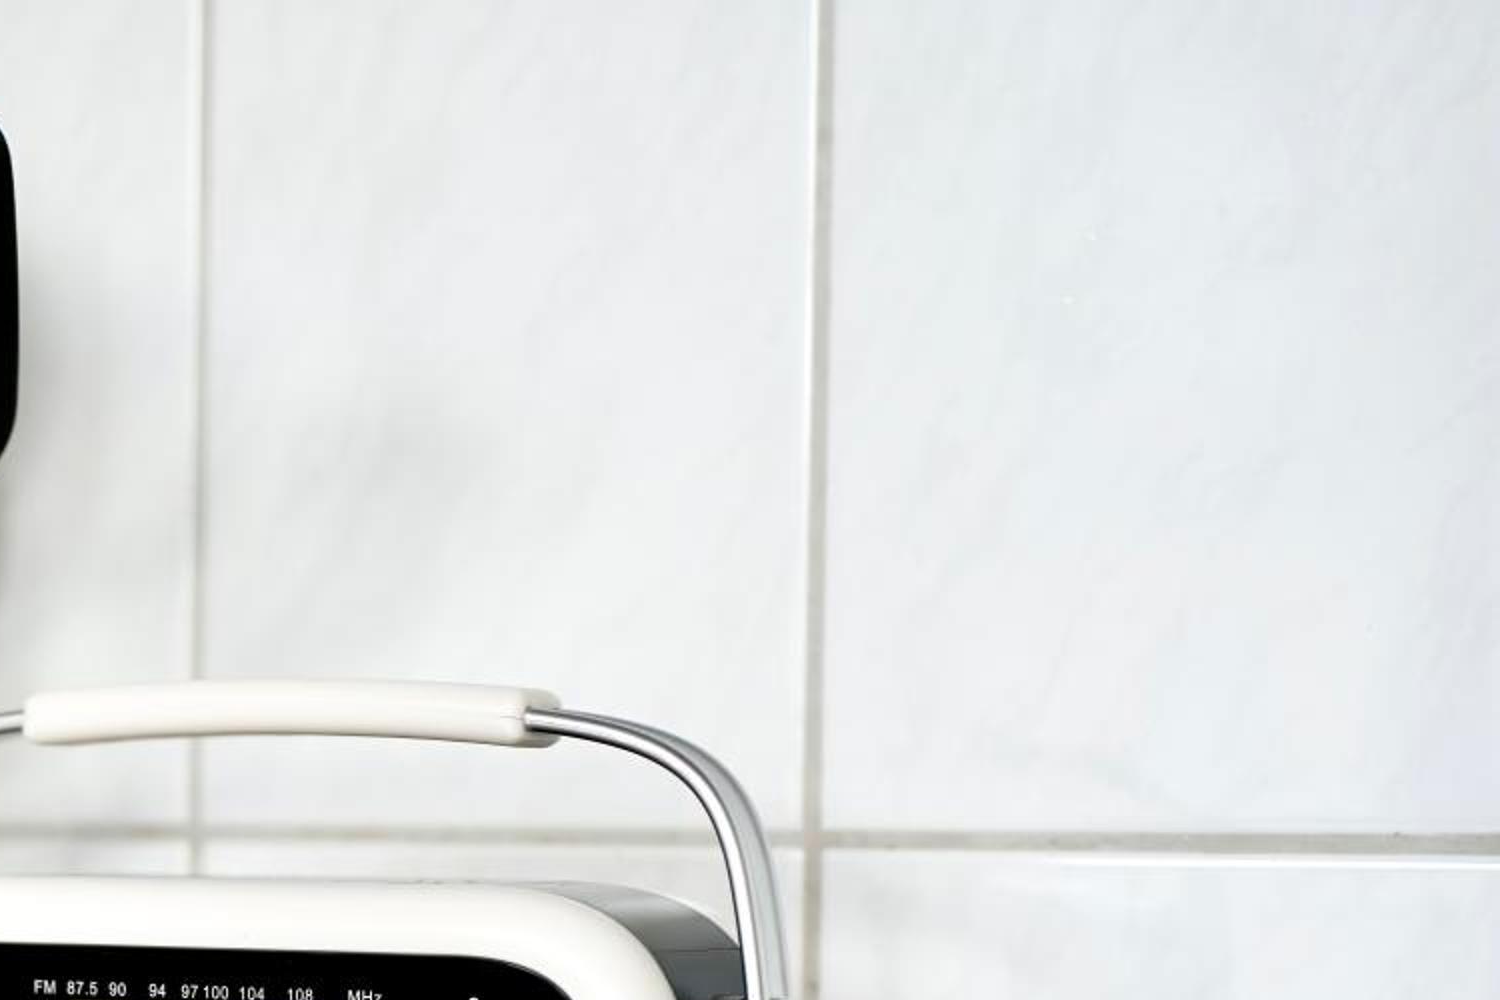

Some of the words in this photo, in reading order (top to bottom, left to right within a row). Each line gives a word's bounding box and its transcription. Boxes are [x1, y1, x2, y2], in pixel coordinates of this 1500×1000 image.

[33, 979, 57, 995] FM
[66, 980, 99, 996] 87.5
[108, 981, 127, 997] 90
[148, 983, 167, 998] 94
[180, 984, 199, 999] 97
[202, 985, 230, 1000] 100
